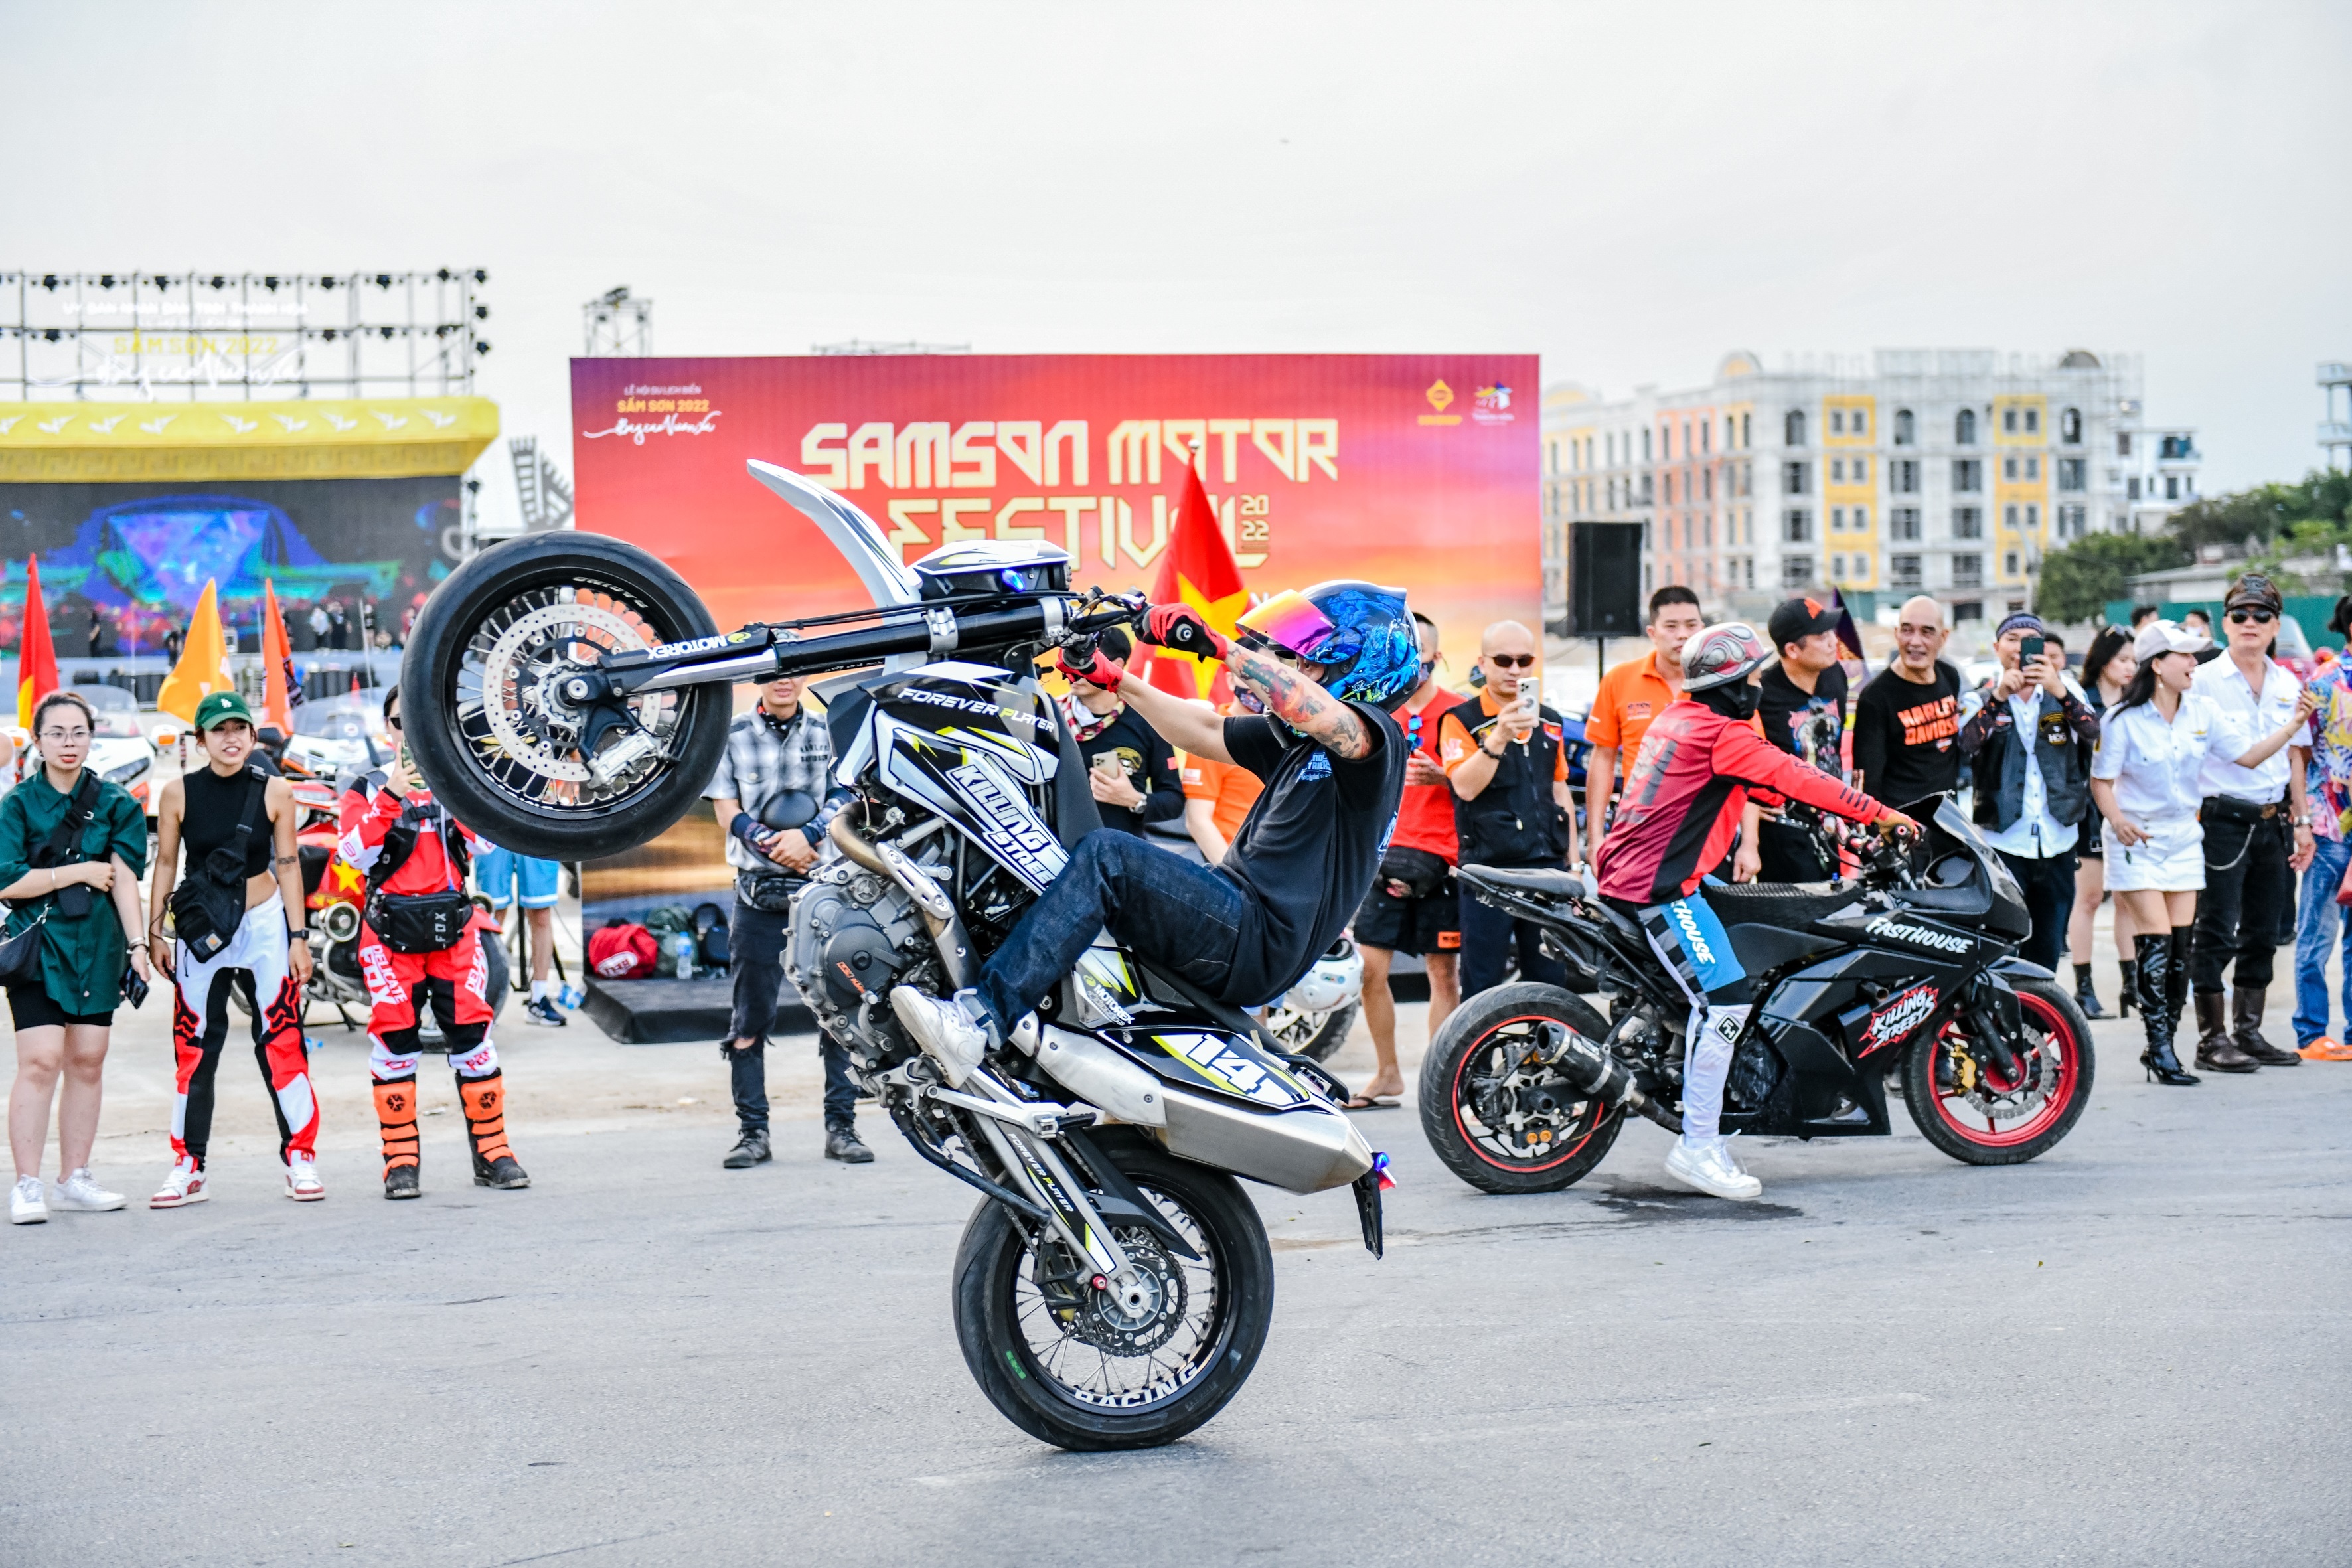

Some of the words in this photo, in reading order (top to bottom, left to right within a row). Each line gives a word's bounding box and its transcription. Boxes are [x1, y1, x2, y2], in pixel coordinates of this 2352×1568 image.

[225, 336, 279, 355] 2022
[677, 398, 710, 412] 2022
[801, 420, 1089, 490] SAMSON
[1107, 418, 1338, 485] MOTOR
[888, 493, 1269, 570] FESTIVL
[1239, 493, 1269, 516] 20
[1241, 520, 1269, 542] 22
[644, 635, 728, 660] MOTOREX
[897, 688, 1000, 716] FOREVER
[999, 707, 1056, 732] PLAYER
[950, 765, 1052, 854] KILLING
[435, 911, 447, 943] FOX
[1865, 917, 1974, 954] FASTHOUSE
[372, 944, 408, 1004] DELICATE
[1093, 984, 1135, 1025] MOTOREX
[1871, 989, 1927, 1036] KILLING
[1872, 994, 1936, 1049] STREETS
[1008, 1133, 1047, 1176] FOREVER
[1042, 1177, 1074, 1212] PLAYER
[1075, 1362, 1198, 1408] RACING
